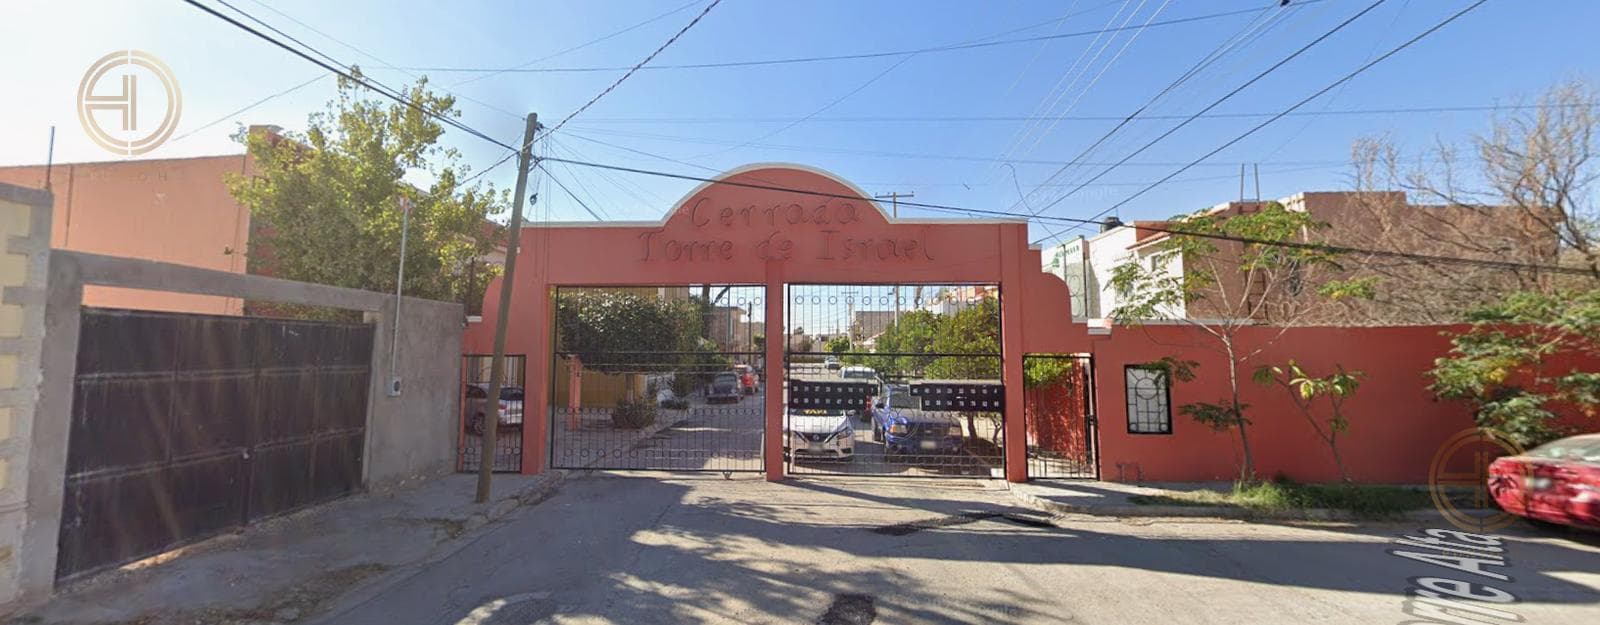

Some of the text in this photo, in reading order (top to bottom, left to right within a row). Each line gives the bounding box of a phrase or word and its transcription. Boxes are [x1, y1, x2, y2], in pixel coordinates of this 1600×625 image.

[691, 196, 859, 227] Cerrada
[638, 228, 935, 262] Torre de Israel
